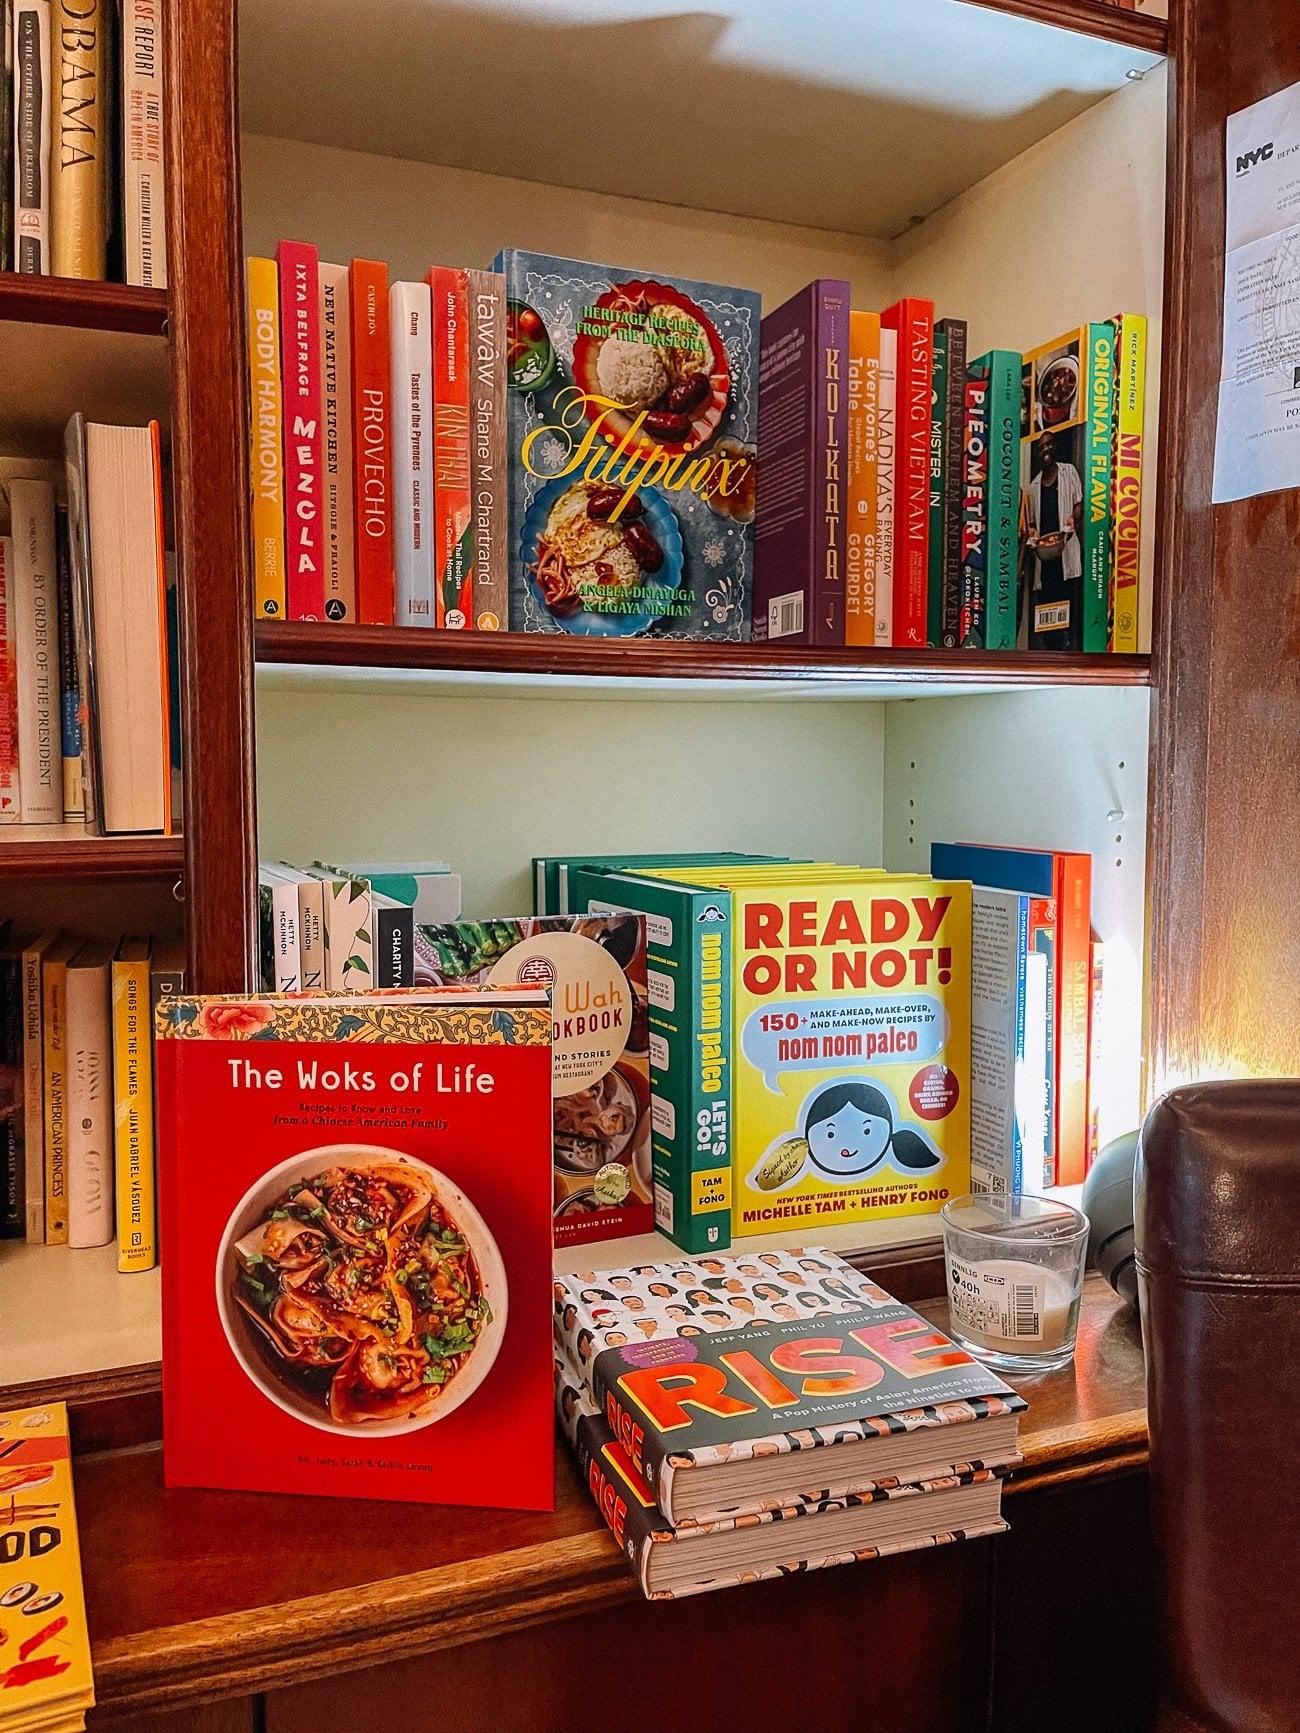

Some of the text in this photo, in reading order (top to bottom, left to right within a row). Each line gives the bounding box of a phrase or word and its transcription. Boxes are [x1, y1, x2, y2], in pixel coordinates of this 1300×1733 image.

[25, 20, 32, 35] ON
[26, 132, 34, 144] OF
[26, 148, 34, 197] FREEDOM
[1236, 142, 1274, 173] NYC
[295, 264, 309, 396] IXTA BELFRAGE
[410, 312, 418, 336] Chang
[446, 292, 456, 382] John Chantarasak
[476, 293, 499, 387] tawâw
[575, 322, 707, 352] FROM THE DIASPORA
[583, 305, 702, 335] HERITAGE RECIPES
[255, 308, 280, 504] BODY HARMONY
[324, 286, 338, 474] NEW NATIVE KITCHEN
[911, 317, 928, 421] TASTING
[949, 328, 963, 416] BETWEEN
[410, 373, 421, 472] Tastes of the Pyrenees
[849, 357, 879, 463] Everyone's Table
[1090, 338, 1111, 523] ORIGINAL FLAVA
[293, 416, 317, 573] MEZCLA
[363, 389, 385, 539] PROVECHO
[477, 397, 494, 586] Shane M. Chartrand
[521, 386, 752, 524] Filipinx
[825, 348, 840, 580] KOLKATA
[877, 408, 894, 514] NADIYA'S
[908, 430, 927, 540] VIETNAM
[930, 420, 942, 508] MISTER IN
[948, 419, 962, 507] HARLEM
[30, 516, 38, 564] ROBINSON
[329, 485, 339, 591] BITSOIE & FRAIOLI
[948, 511, 960, 550] AND
[999, 418, 1014, 616] COCONUT & SAMBAL
[1116, 432, 1142, 590] MI COCINA
[264, 537, 277, 577] BERRIE
[579, 584, 696, 603] ANGELA DIMAYUGA
[848, 534, 860, 615] GOURDET
[863, 534, 874, 617] GREGORY
[946, 558, 958, 631] HEAVEN
[583, 600, 692, 618] & LIGAYA MISHAN
[973, 612, 980, 626] KO
[34, 574, 52, 788] BY ORDER OF THE PRESIDENT
[392, 928, 402, 981] CHARITY
[744, 896, 952, 950] READY
[28, 958, 38, 1040] Yoshiko Uchida
[565, 980, 623, 1014] Wah
[742, 946, 952, 996] OR NOT!
[810, 1004, 931, 1018] MAKE-AHEAD, MAKE-OVER,
[128, 980, 138, 1095] SONGS FOR THE FLAMES
[697, 932, 727, 1092] nom nom paleo
[778, 1026, 918, 1062] nom nom paleo
[810, 1014, 936, 1030] AND MAKE-NOW RECIPES BY
[228, 1059, 496, 1094] The Woks of Life
[52, 1072, 64, 1198] AN AMERICAN PRINCESS
[130, 1108, 141, 1223] JUAN GABRIEL VÁSQUEZ
[696, 1108, 712, 1152] GO!
[712, 1100, 726, 1156] LET'S
[698, 1194, 725, 1206] FONG
[702, 1177, 722, 1188] TAM
[742, 1188, 950, 1223] MICHELLE TAM + HENRY FONG
[777, 1183, 918, 1205] NEW YORK TIMES BESTSELLING AUTHORS
[554, 1217, 622, 1232] SHUA DAVID STEIN
[708, 1310, 907, 1345] JEFF YANG PHIL YU PHILIP WANG
[960, 1280, 980, 1295] 40h
[616, 1318, 976, 1433] RISE
[772, 1376, 992, 1420] A Pop History of Asian America from
[606, 1390, 644, 1475] RISE
[588, 1458, 628, 1550] RISE
